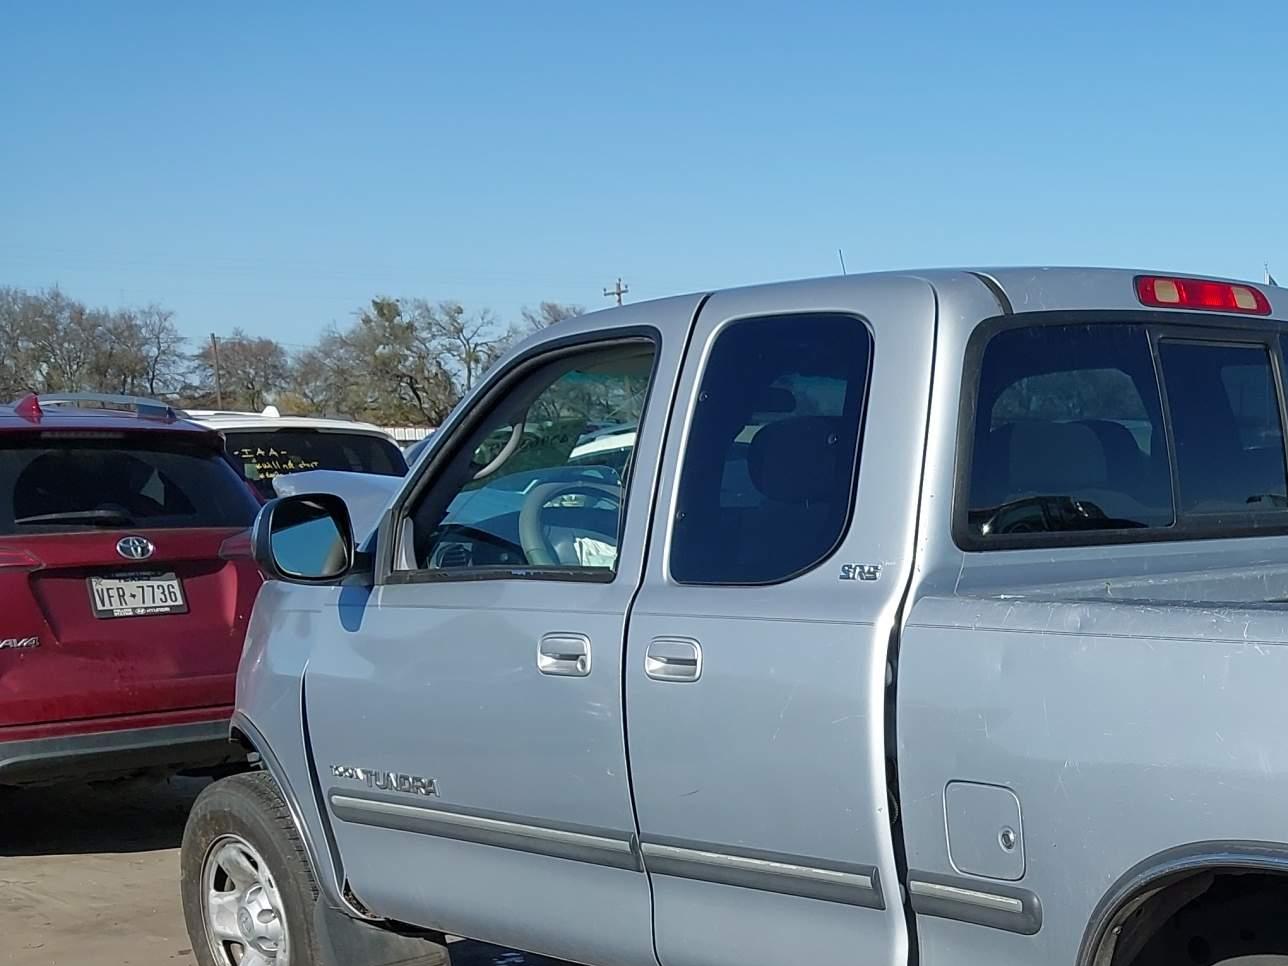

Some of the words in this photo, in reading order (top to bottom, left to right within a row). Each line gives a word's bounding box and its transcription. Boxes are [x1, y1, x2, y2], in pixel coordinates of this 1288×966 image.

[839, 564, 881, 581] SR5
[95, 586, 128, 608] VFR
[136, 583, 178, 605] 7736
[0, 636, 40, 648] AV4
[362, 768, 441, 798] TUNDRA
